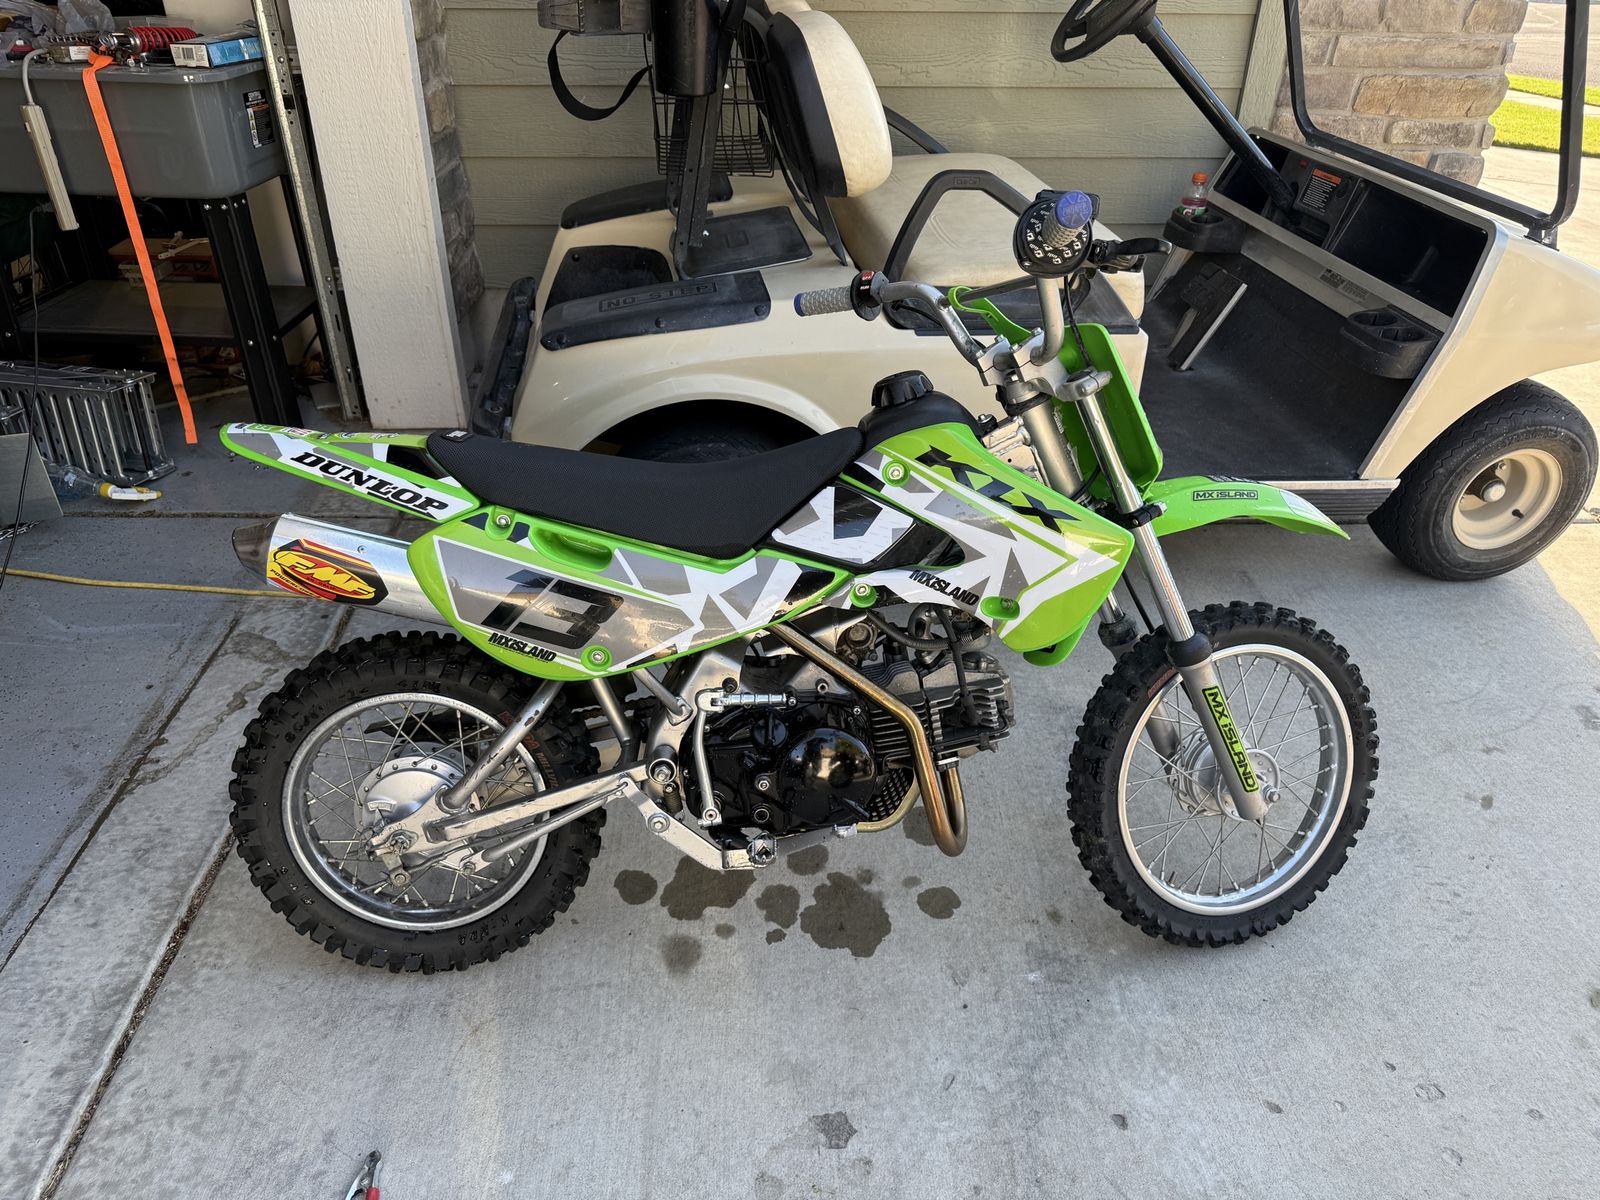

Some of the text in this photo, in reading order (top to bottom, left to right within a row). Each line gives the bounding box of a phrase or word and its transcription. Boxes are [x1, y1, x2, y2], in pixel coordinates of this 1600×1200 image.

[607, 285, 708, 308] NO STEP
[290, 451, 449, 513] DUNLOP
[1195, 490, 1214, 499] MX
[275, 551, 377, 597] FMF
[480, 568, 625, 650] 13
[1207, 690, 1229, 721] MX
